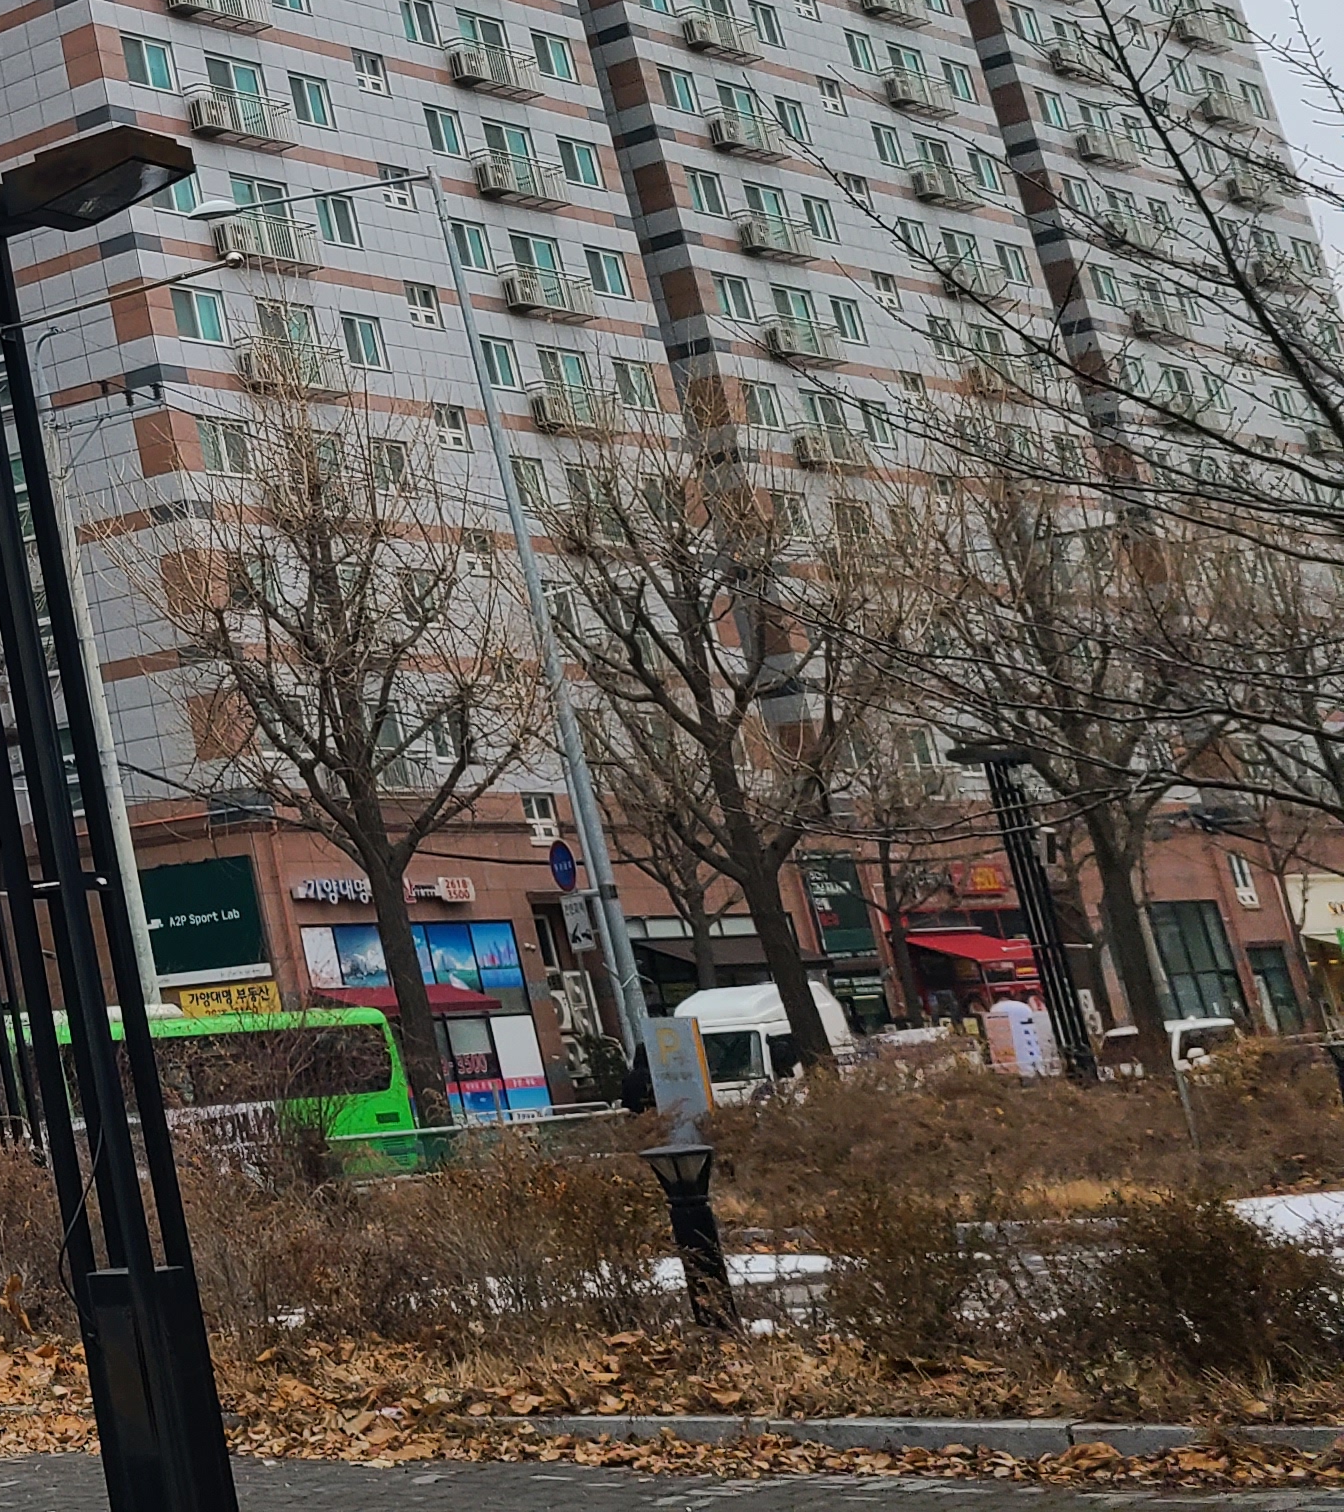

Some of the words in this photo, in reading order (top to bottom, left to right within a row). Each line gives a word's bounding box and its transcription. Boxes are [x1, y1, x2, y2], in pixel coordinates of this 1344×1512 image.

[305, 877, 374, 905] 가양대명
[169, 914, 187, 928] A2P
[189, 910, 219, 927] Sport
[221, 908, 241, 921] Lab
[188, 989, 233, 1008] 가양대명
[236, 985, 271, 1003] 부동산
